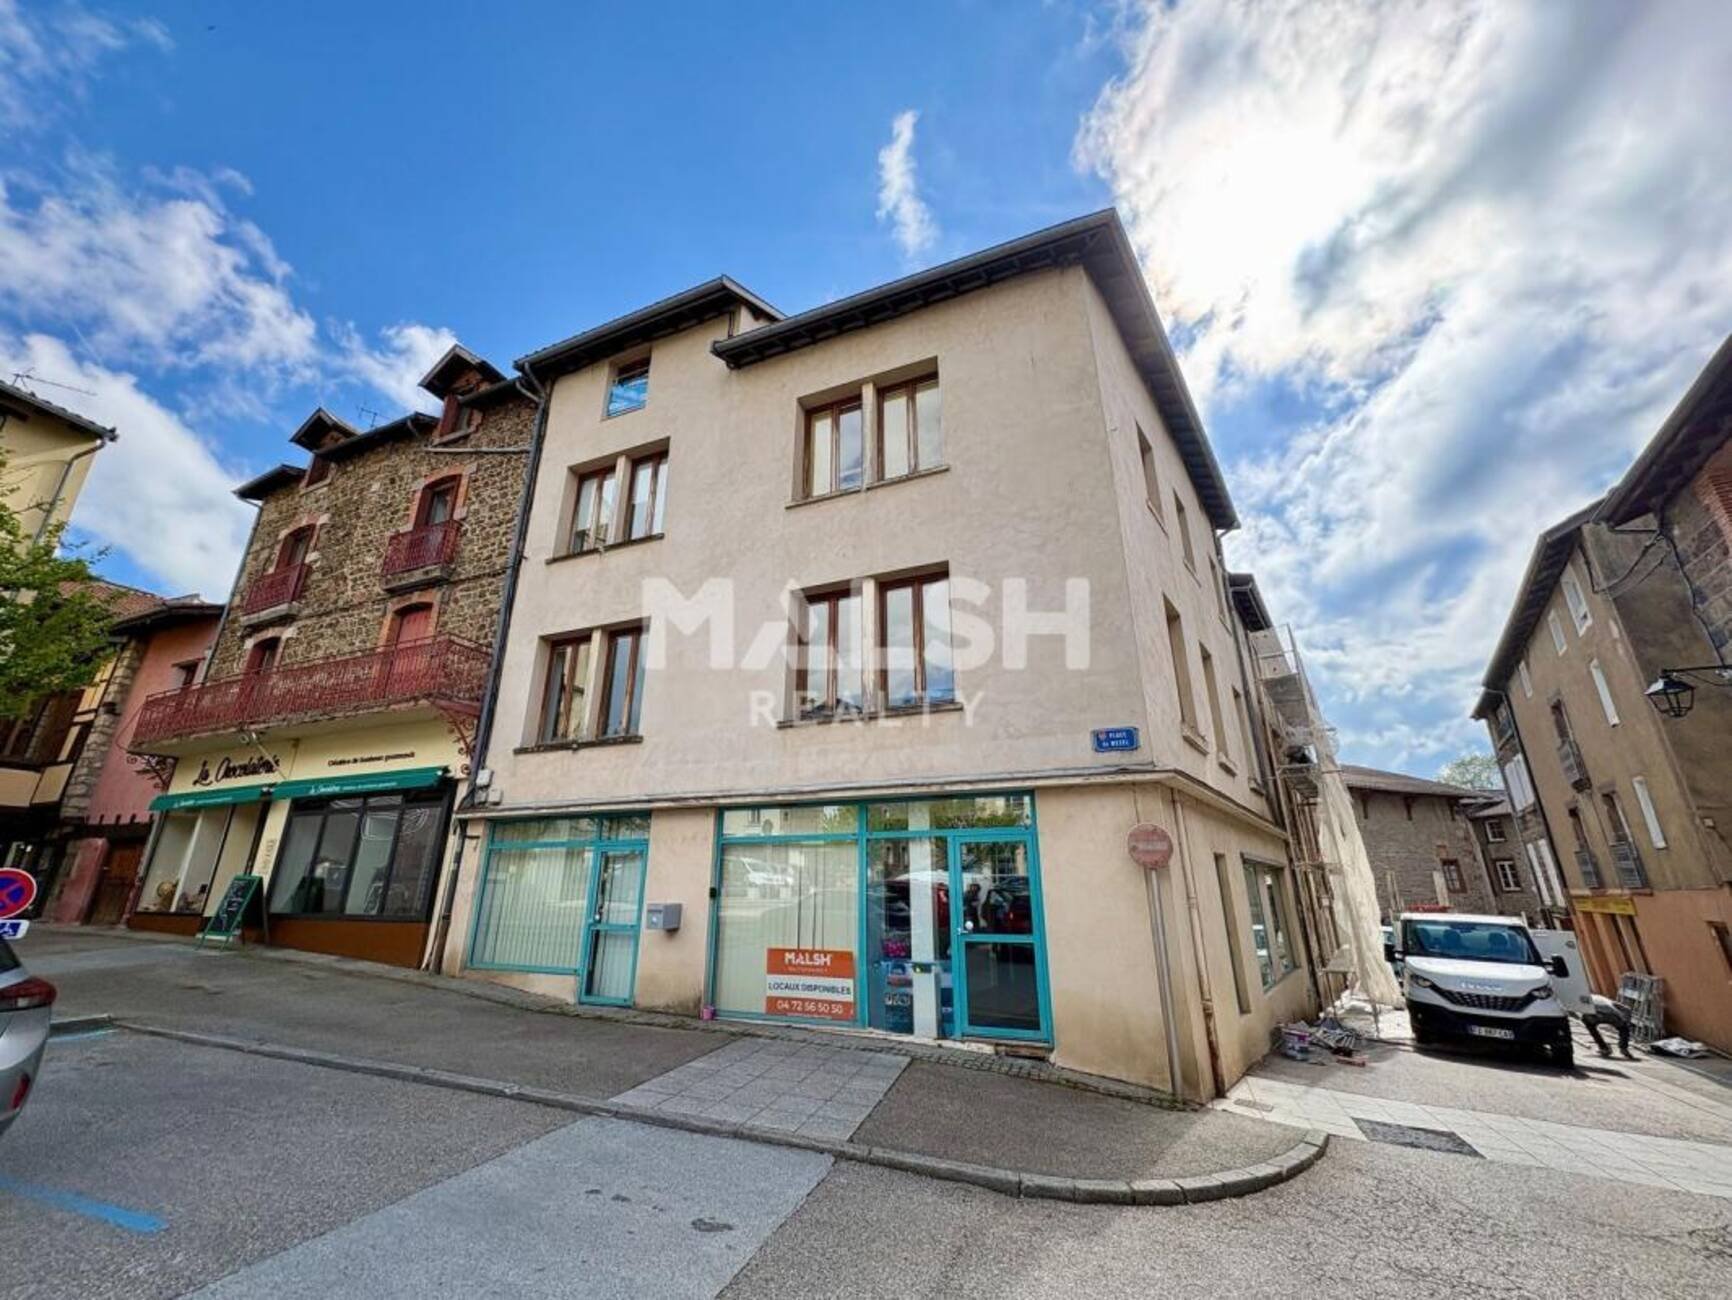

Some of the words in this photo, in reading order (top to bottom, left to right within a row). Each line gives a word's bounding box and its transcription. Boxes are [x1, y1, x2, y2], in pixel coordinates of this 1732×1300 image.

[784, 952, 832, 966] MALSH
[768, 982, 800, 992] LOCAUX
[801, 983, 851, 995] DISPONIBLES
[777, 1000, 790, 1010] 04
[790, 1001, 803, 1012] 72
[804, 1002, 817, 1012] 56
[818, 1003, 830, 1013] 50
[831, 1004, 844, 1015] 50
